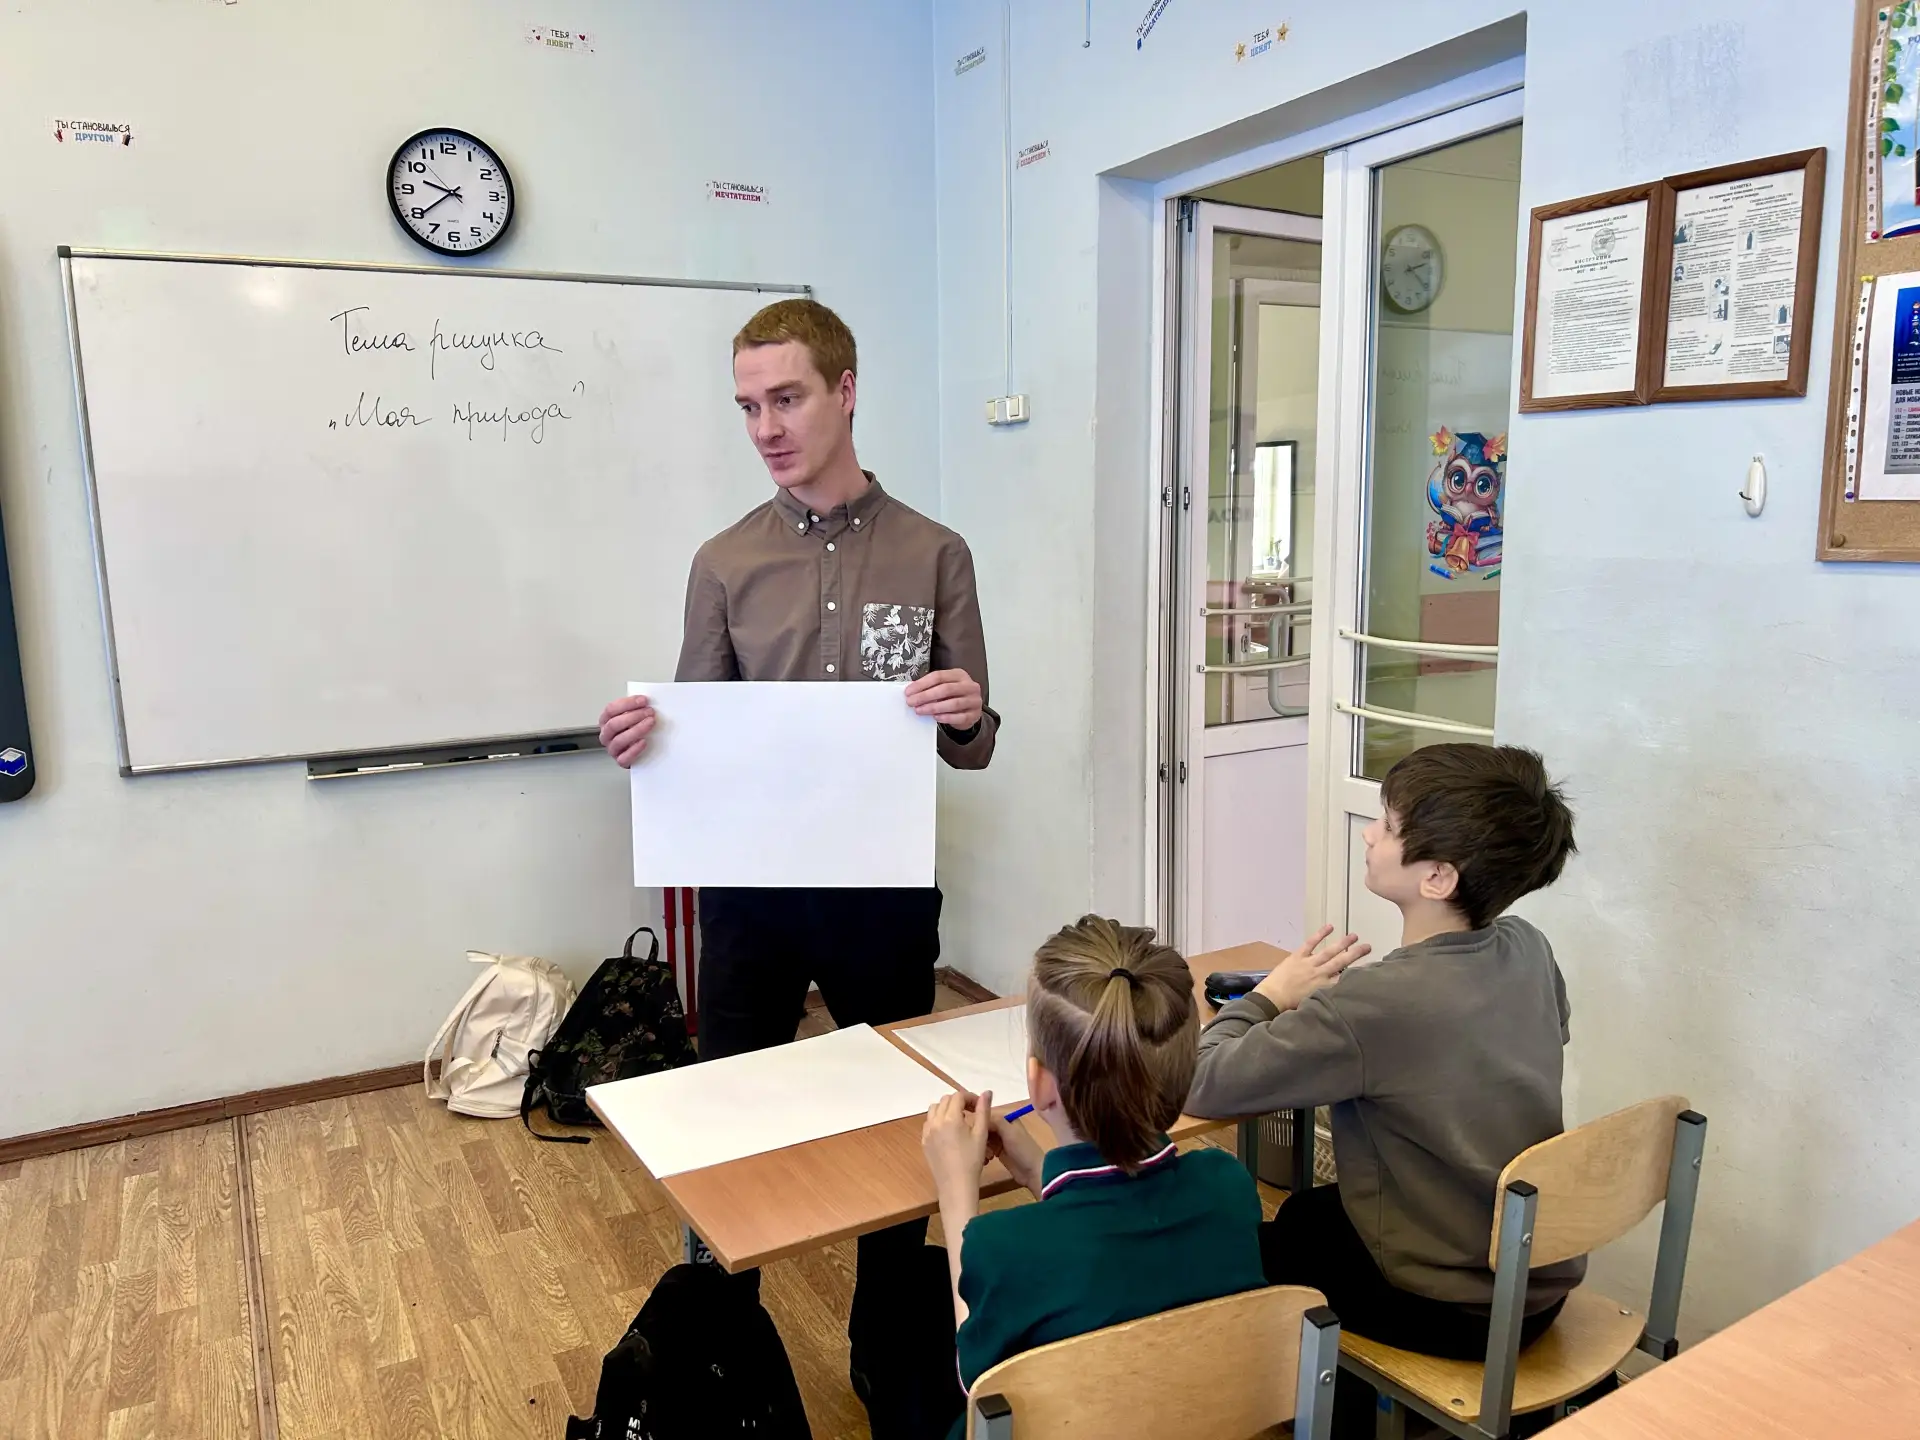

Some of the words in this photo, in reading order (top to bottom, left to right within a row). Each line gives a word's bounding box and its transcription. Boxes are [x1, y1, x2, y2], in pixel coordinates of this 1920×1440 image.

[550, 29, 570, 39] ТЕБЯ
[1253, 28, 1270, 43] ТЕБЯ
[55, 119, 69, 129] ТЫ
[70, 120, 130, 133] СТАНОВИШЬСЯ
[75, 132, 114, 142] ДРУГОМ
[422, 148, 435, 161] 11
[440, 142, 457, 155] 12
[468, 150, 473, 162] 1
[407, 160, 427, 174] 10
[480, 168, 493, 181] 2
[401, 183, 415, 195] 9
[712, 180, 722, 189] ТЫ
[488, 191, 500, 202] 3
[715, 190, 761, 202] МЕЧТАТЕЛЕМ
[410, 207, 425, 220] 8
[482, 211, 494, 223] 4
[428, 222, 441, 234] 7
[470, 226, 482, 237] 5
[447, 231, 461, 243] 6
[330, 306, 416, 356] Тема
